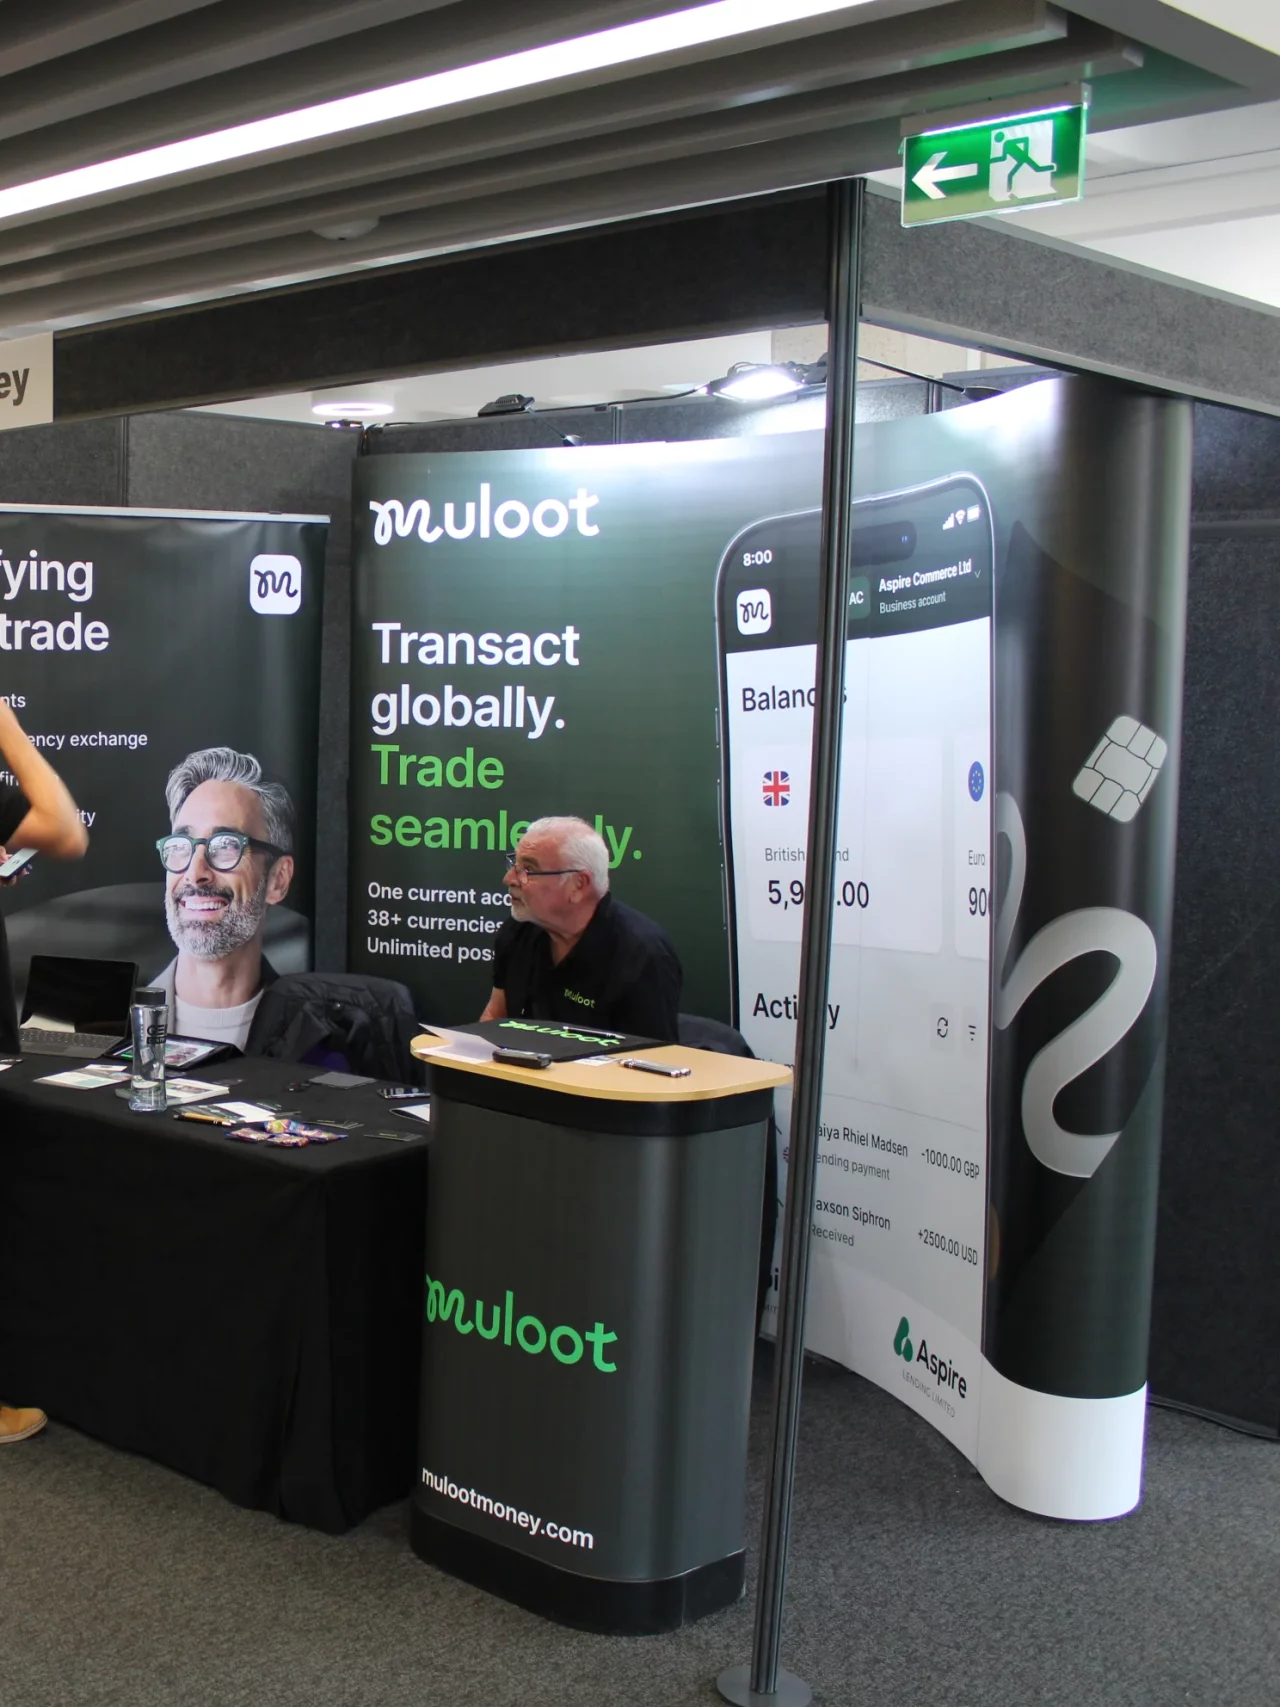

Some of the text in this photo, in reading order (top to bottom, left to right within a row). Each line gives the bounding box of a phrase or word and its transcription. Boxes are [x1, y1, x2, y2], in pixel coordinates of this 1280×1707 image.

[369, 482, 600, 546] muloot
[743, 550, 773, 567] 8:00
[878, 558, 972, 593] Aspire Commerce Ltd
[849, 591, 864, 605] AC
[879, 591, 946, 614] Business account
[372, 622, 580, 666] Transact
[371, 684, 566, 740] globally.
[70, 732, 148, 749] exchange
[371, 744, 505, 789] Trade
[765, 848, 805, 862] British
[968, 850, 986, 866] Euro
[368, 882, 403, 900] One
[408, 887, 476, 904] current
[368, 909, 402, 927] 38+
[367, 936, 453, 958] Unlimited
[818, 1123, 908, 1157] aiya Rhiel Madsen
[816, 1152, 890, 1180] ending payment
[921, 1149, 980, 1180] -1000.00 GBP
[815, 1199, 891, 1230] axson Siphron
[918, 1228, 978, 1266] +2500.00 USD
[426, 1275, 618, 1373] muloot
[916, 1339, 967, 1399] Aspire
[902, 1369, 956, 1418] LENDING LIMITED
[422, 1467, 594, 1549] mulootmoney.com
